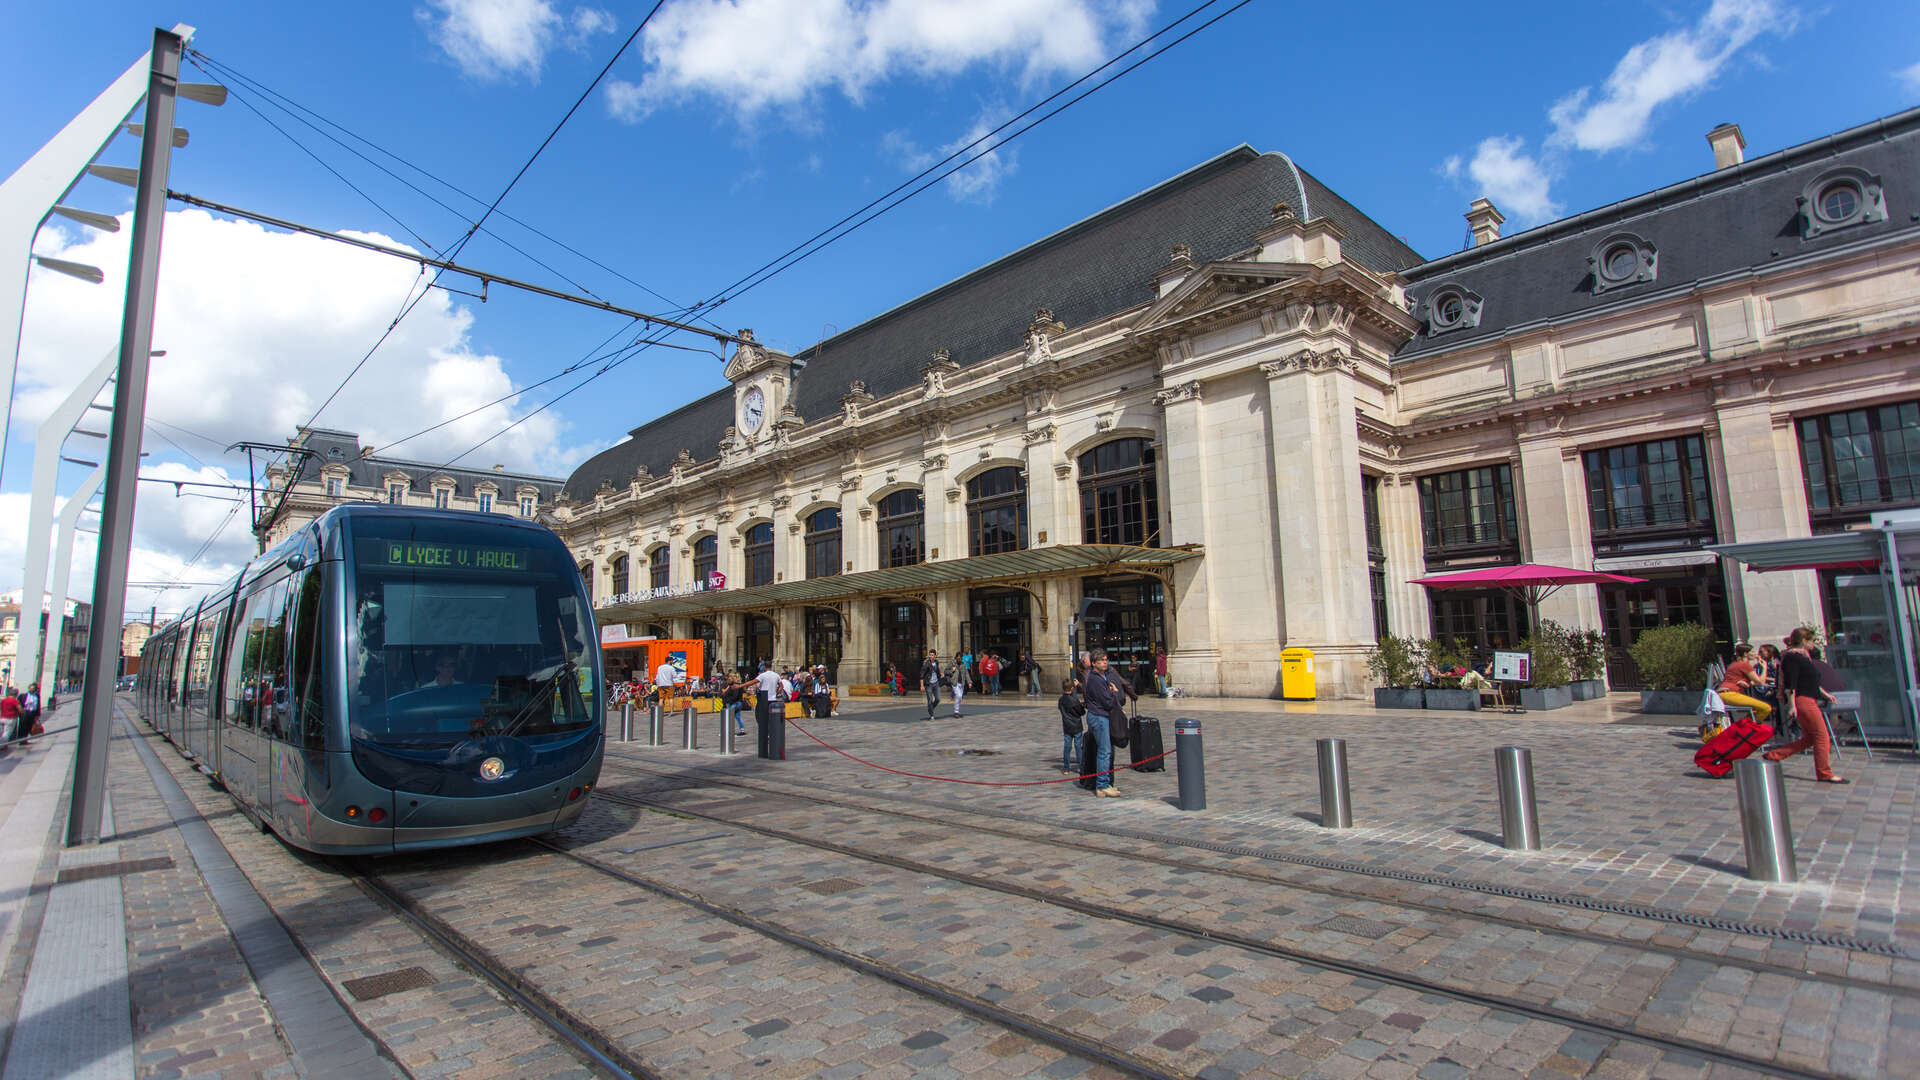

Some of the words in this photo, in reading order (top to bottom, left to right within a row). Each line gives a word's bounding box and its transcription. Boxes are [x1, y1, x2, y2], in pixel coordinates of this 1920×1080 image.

[407, 547, 452, 565] LYCEE
[476, 551, 519, 568] HAVEL
[709, 576, 725, 588] SNCF
